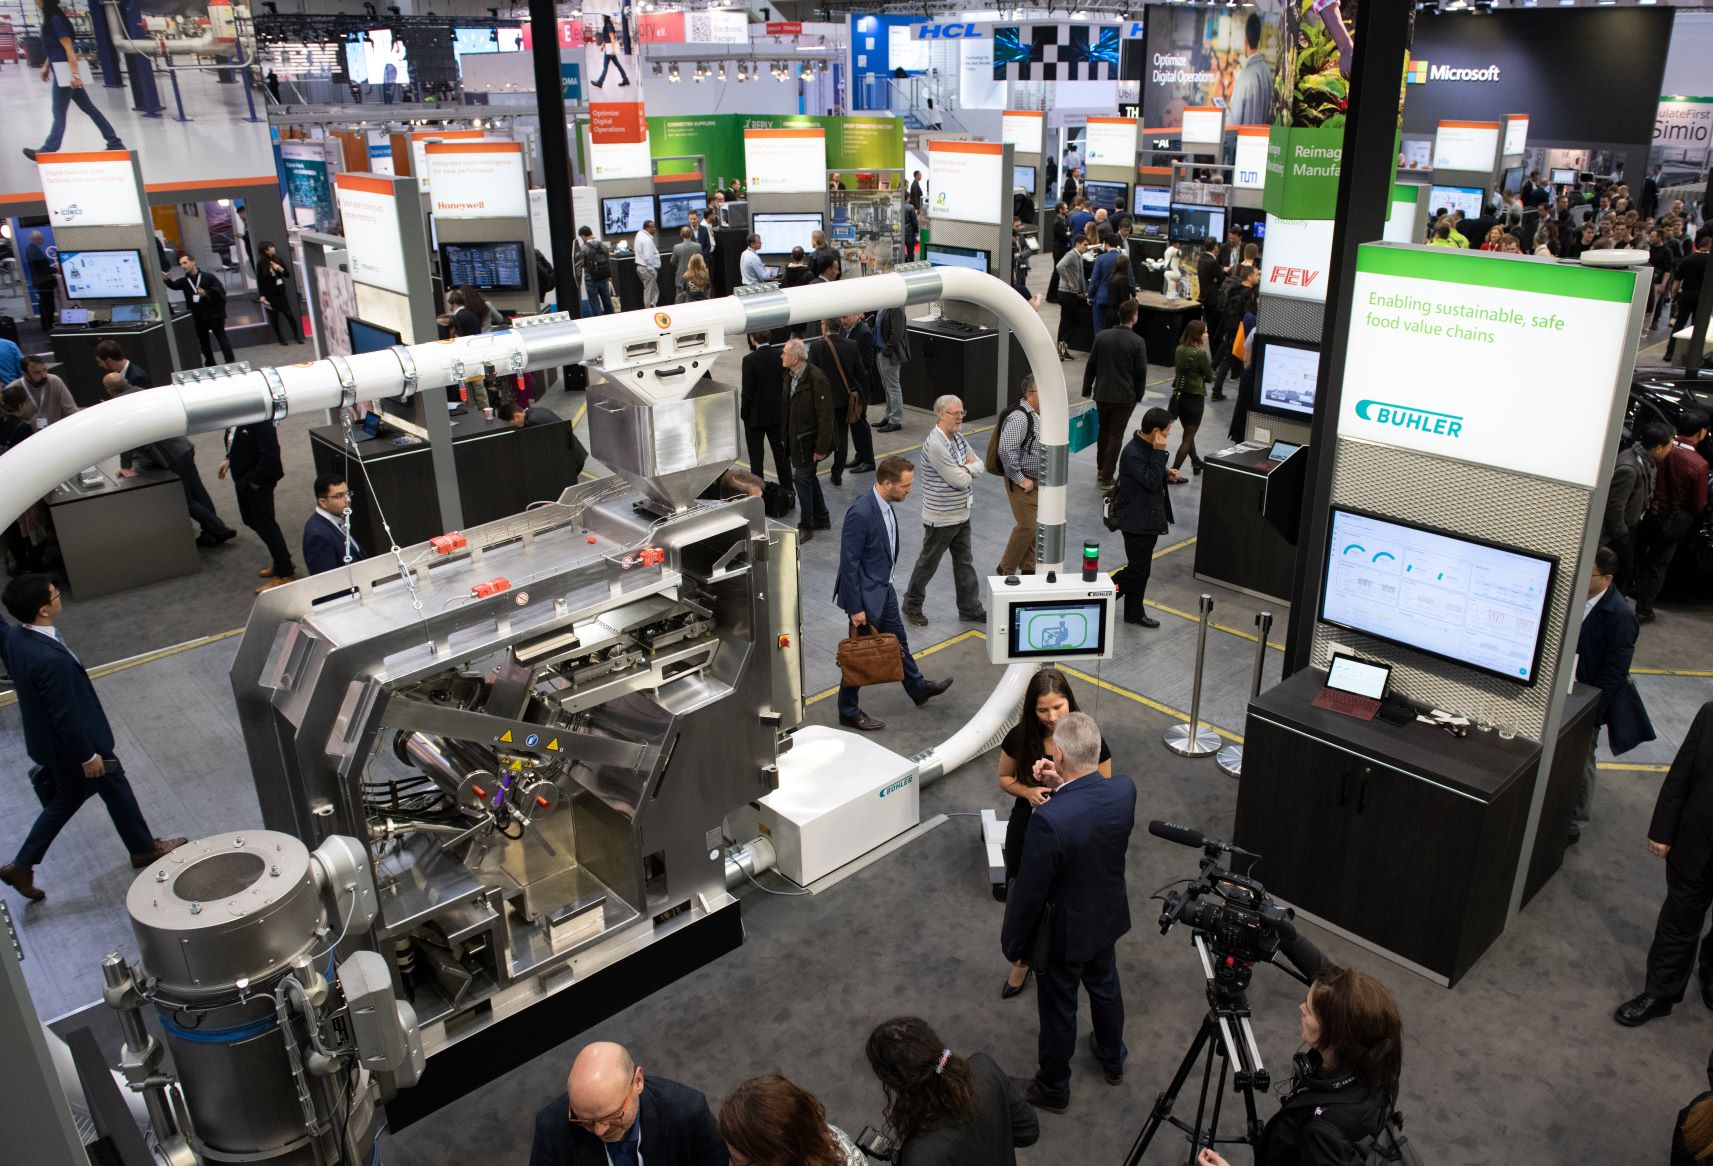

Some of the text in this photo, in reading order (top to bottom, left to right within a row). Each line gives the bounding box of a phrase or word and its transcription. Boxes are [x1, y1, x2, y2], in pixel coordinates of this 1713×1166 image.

[918, 23, 983, 39] HCL
[1152, 53, 1188, 69] Optimize
[1152, 70, 1217, 86] Digital Operations
[1430, 64, 1501, 81] Microsoft
[593, 110, 620, 118] Optimize
[594, 118, 614, 126] Digital
[594, 126, 627, 134] Operations
[751, 120, 774, 129] REPLY
[437, 200, 486, 212] Honeywell
[1270, 266, 1320, 287] FEV
[1368, 291, 1566, 331] Enabling sustainable, safe
[1366, 312, 1495, 344] food value chains
